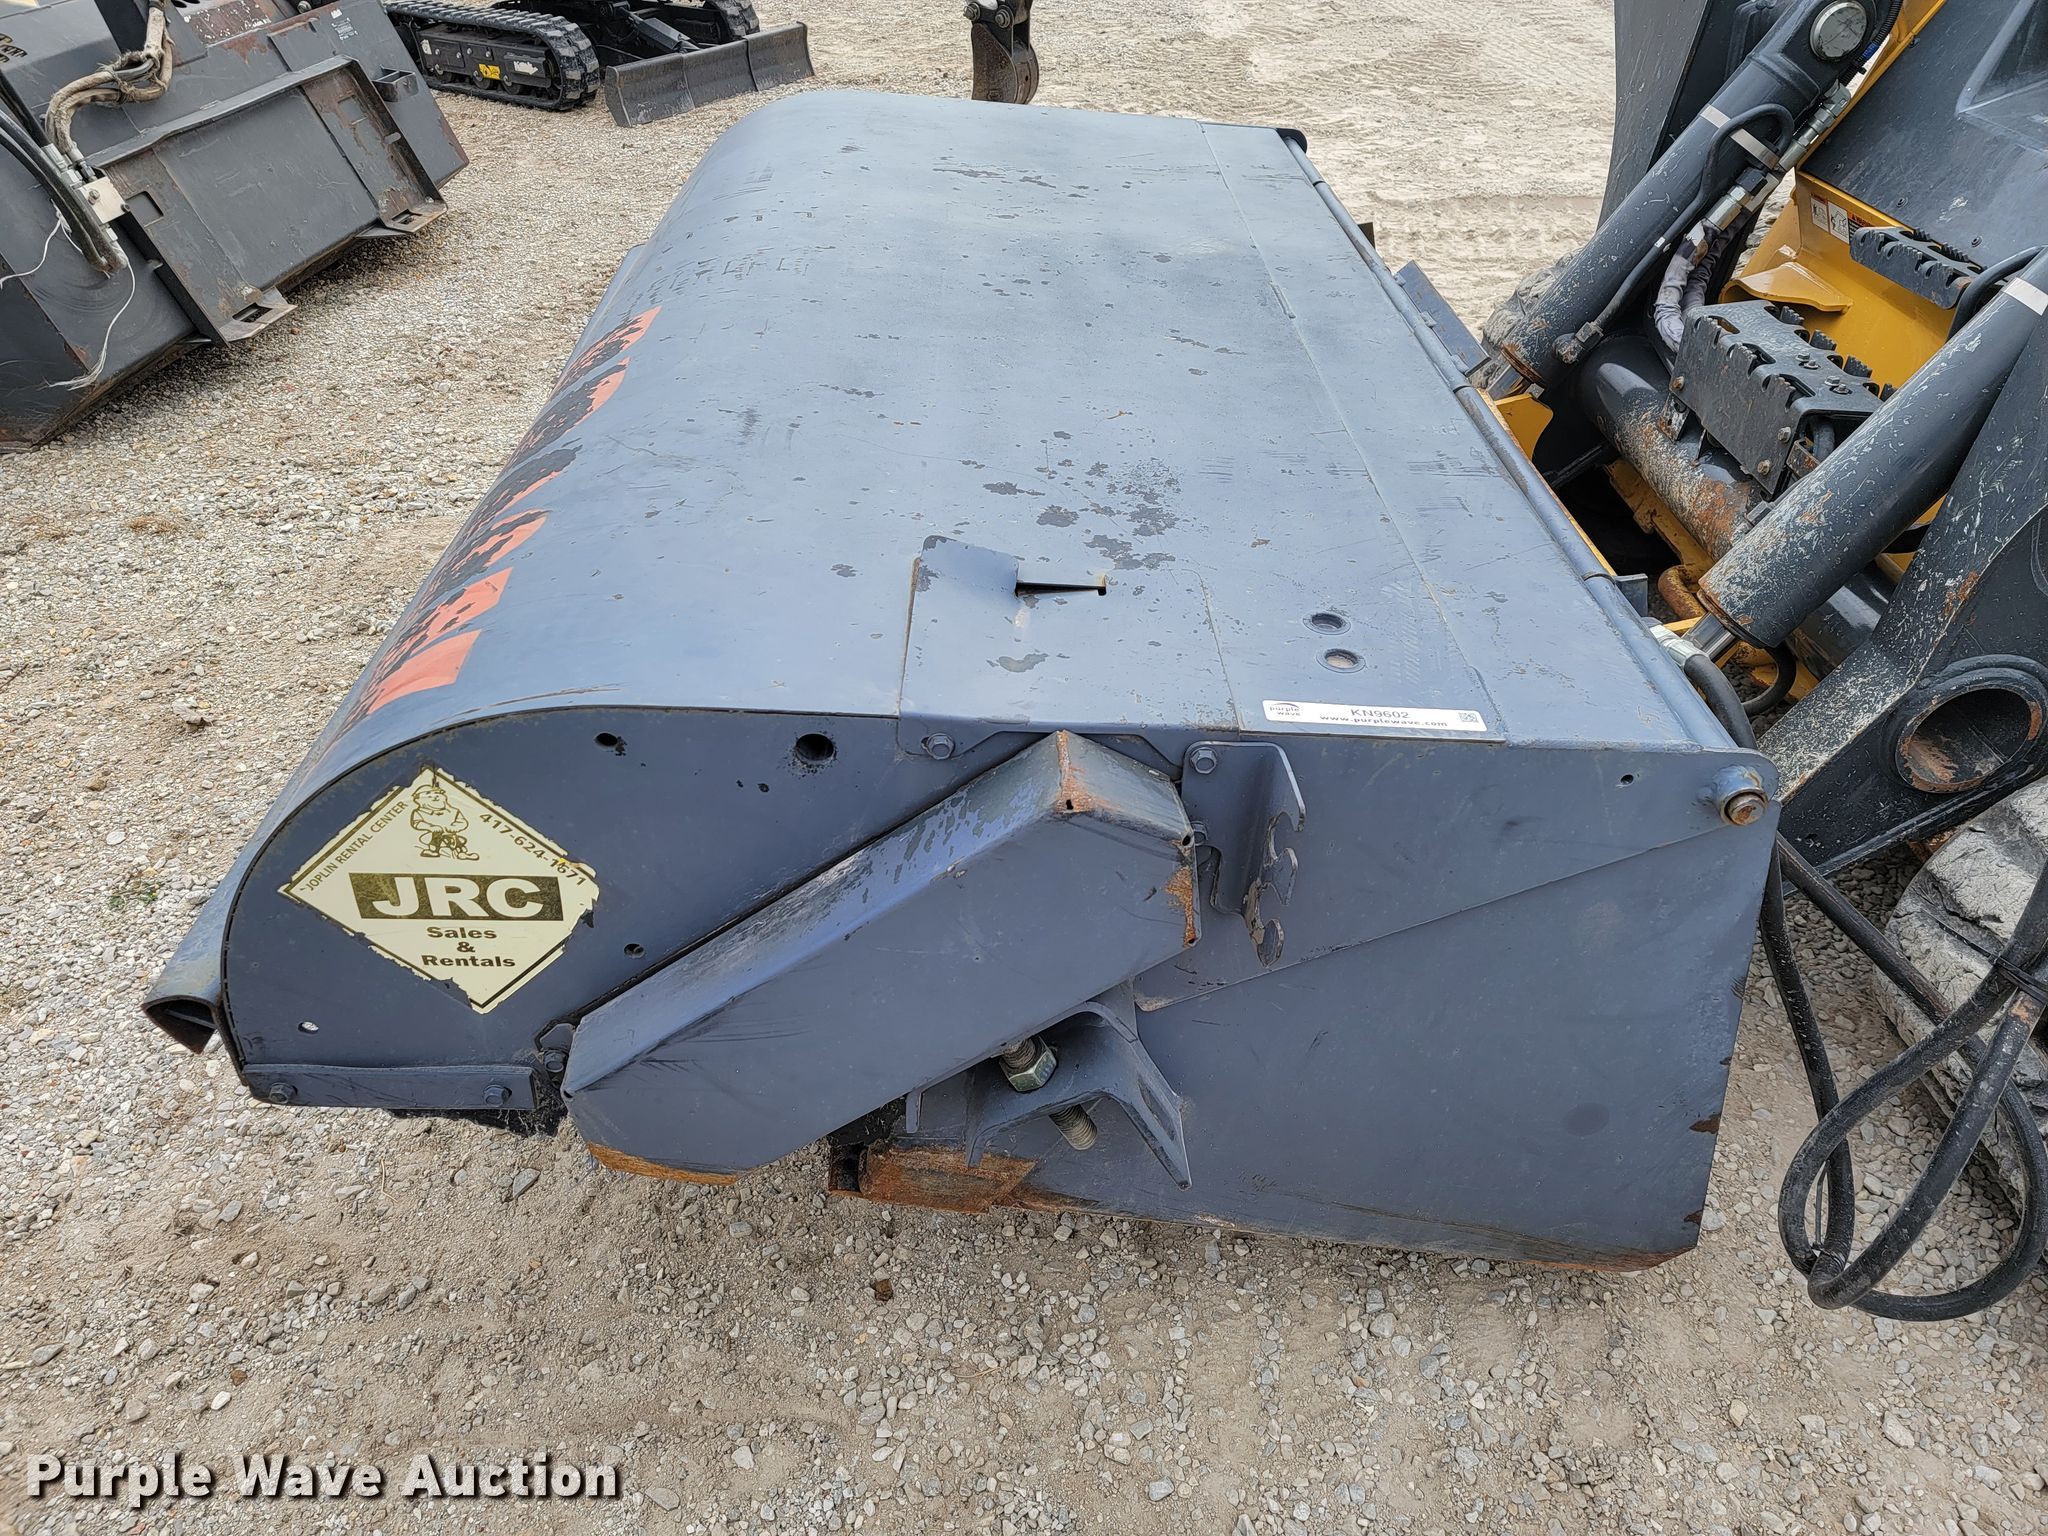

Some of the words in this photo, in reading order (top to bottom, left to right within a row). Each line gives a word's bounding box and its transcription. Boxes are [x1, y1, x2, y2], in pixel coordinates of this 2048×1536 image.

[1270, 705, 1300, 713] purple
[1350, 708, 1410, 719] KN9602
[1319, 715, 1448, 728] www.purplewave.com
[306, 862, 339, 891] JOPLIN
[335, 833, 373, 864] RENTAL
[370, 801, 408, 833] CENTER
[479, 813, 587, 886] 417-624-1671
[371, 876, 545, 918] JRC
[427, 926, 498, 940] Sales
[456, 941, 476, 953] &
[421, 954, 516, 968] Rentals
